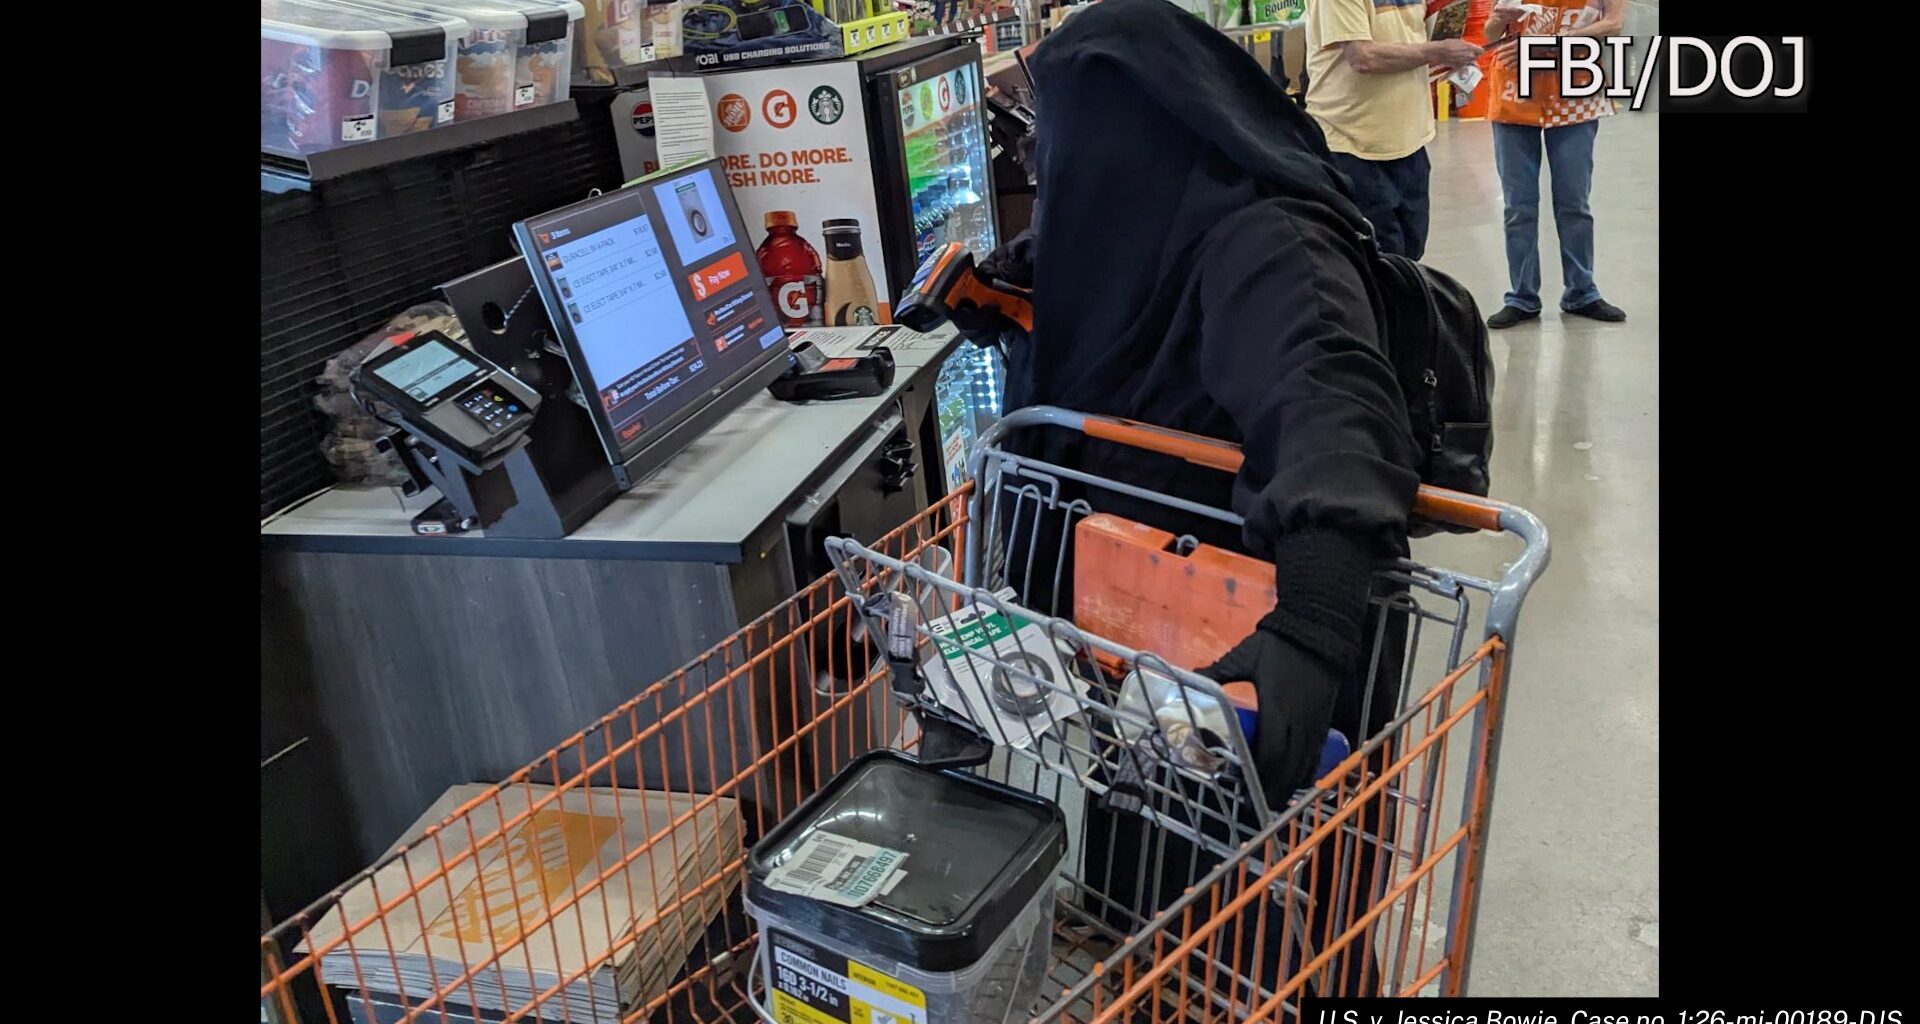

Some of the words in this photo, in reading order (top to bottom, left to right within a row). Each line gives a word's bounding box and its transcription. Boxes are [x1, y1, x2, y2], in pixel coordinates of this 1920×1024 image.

[723, 53, 740, 61] USB
[741, 47, 783, 60] CHARGING
[785, 41, 830, 54] SOLUTIONS
[759, 151, 788, 168] DO
[791, 147, 853, 166] MORE.
[760, 168, 820, 186] MORE.
[708, 275, 719, 285] Pay
[778, 281, 809, 319] G
[781, 952, 819, 977] COMMON
[821, 971, 847, 990] NAILS
[799, 976, 828, 1003] 3-1/2
[829, 992, 839, 1008] in
